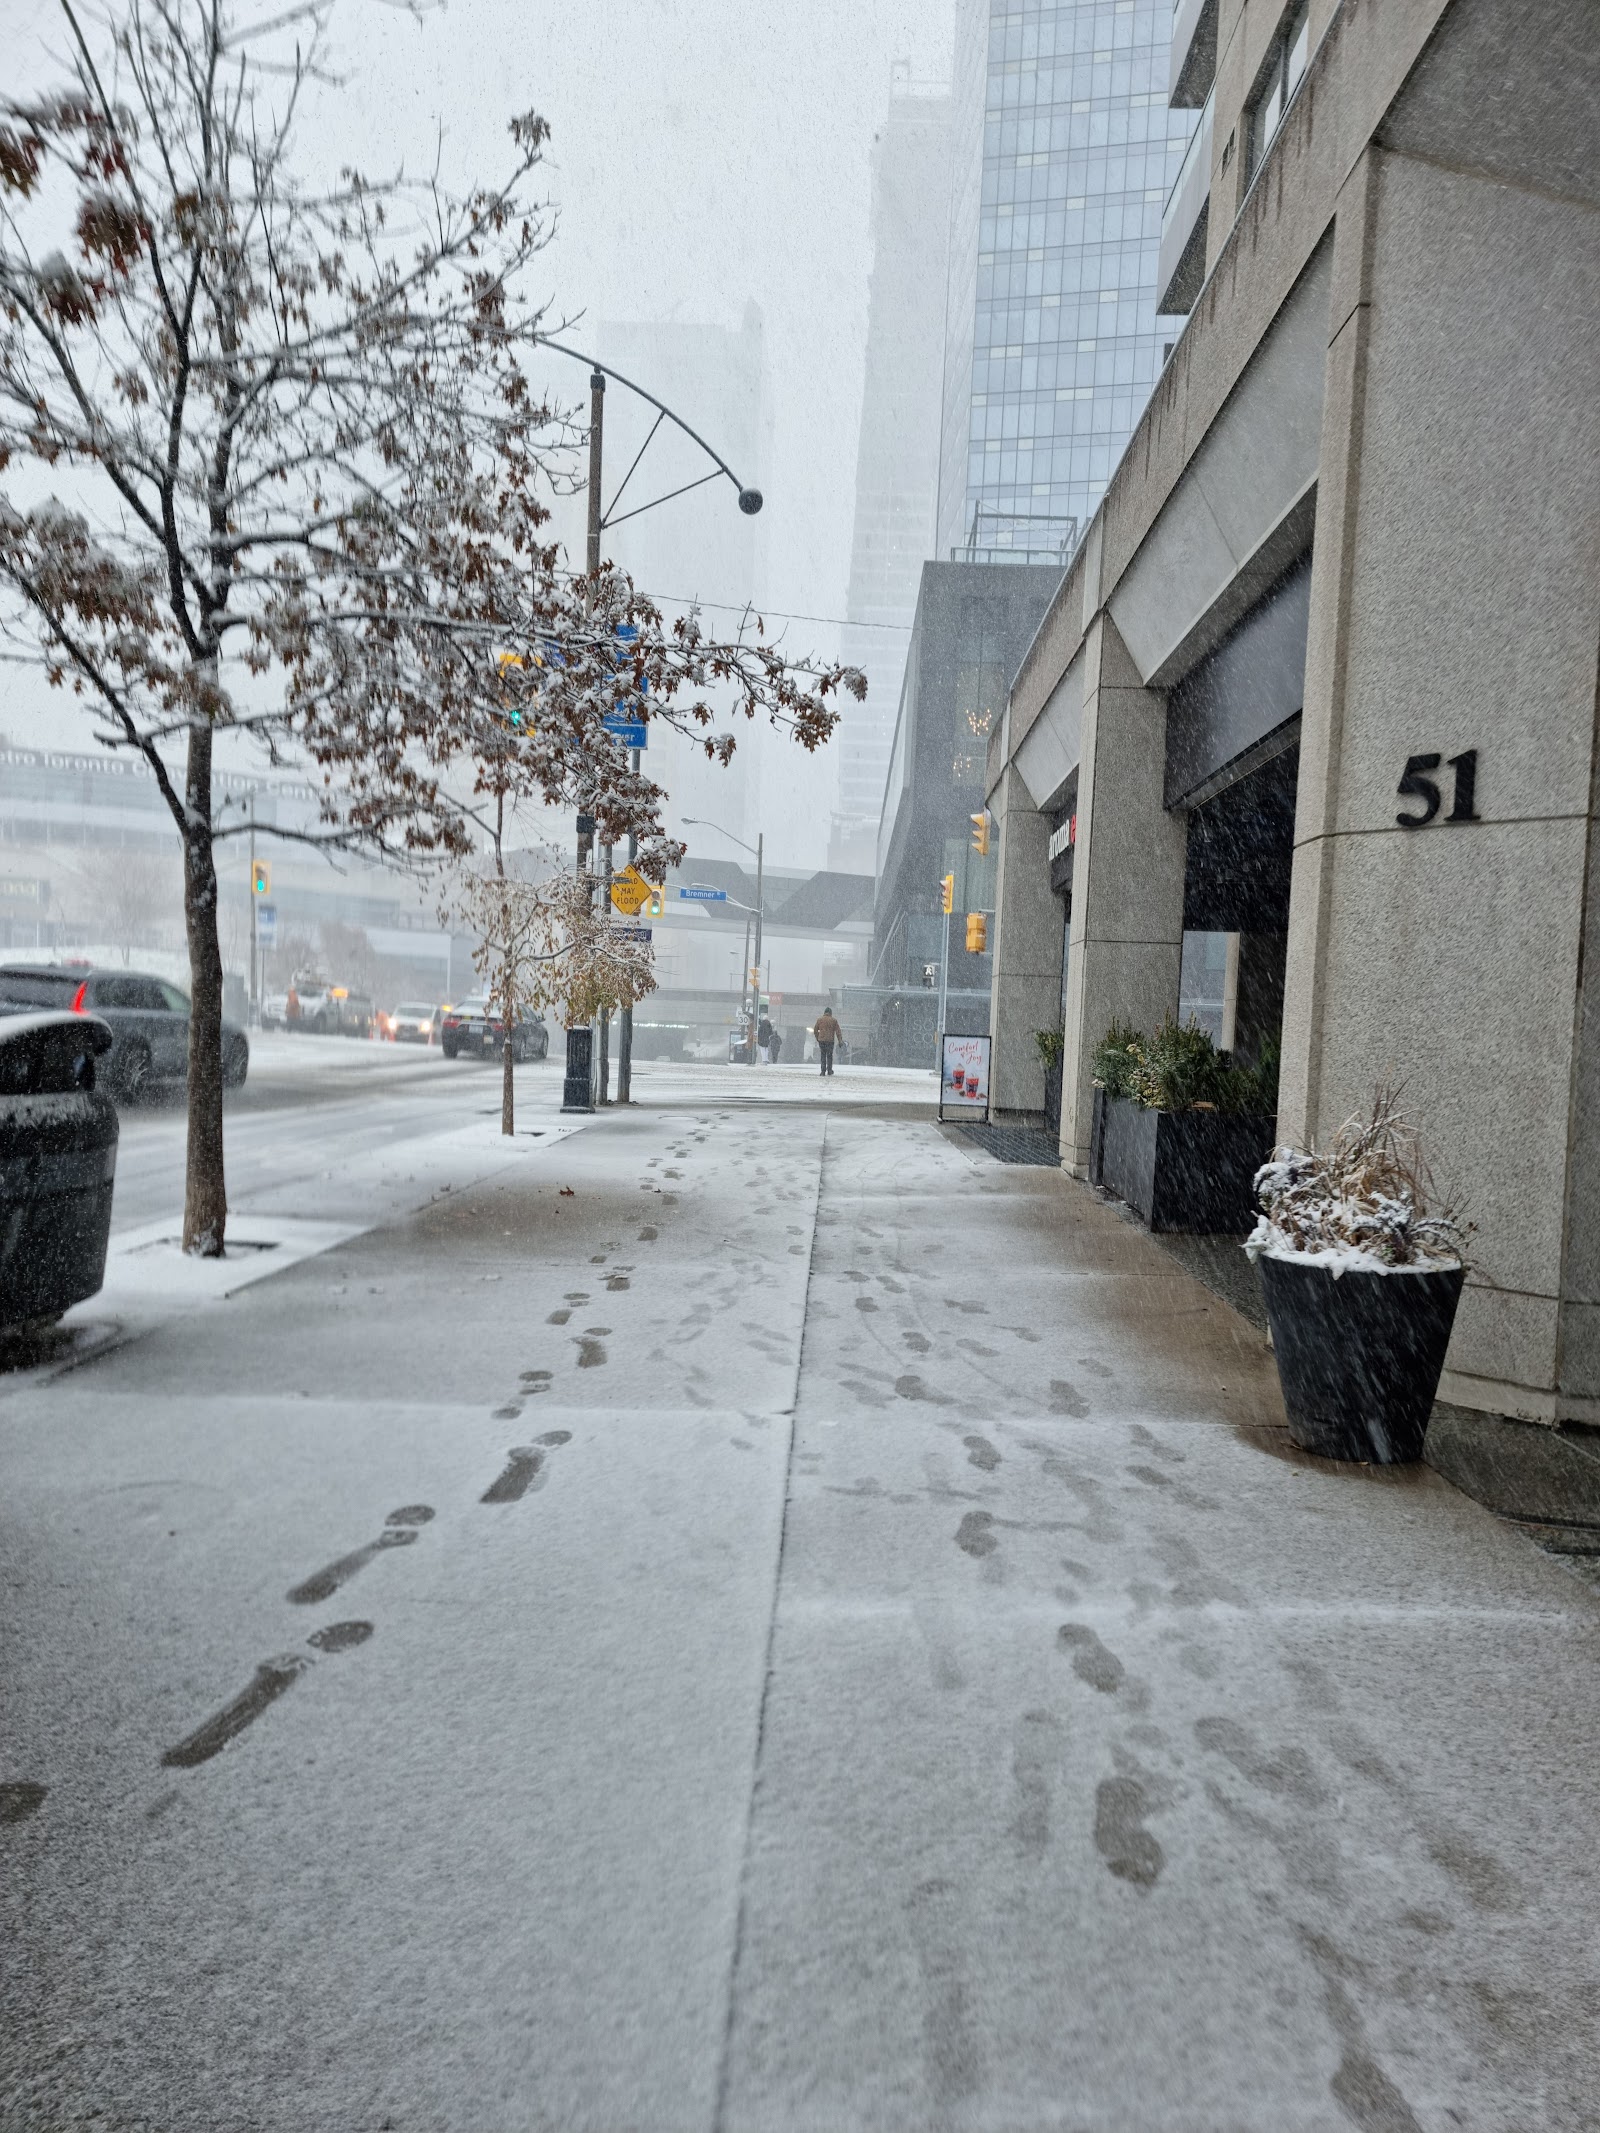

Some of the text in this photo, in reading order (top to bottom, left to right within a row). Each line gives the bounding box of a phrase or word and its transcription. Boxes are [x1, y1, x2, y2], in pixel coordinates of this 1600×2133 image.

[40, 750, 125, 776] Toronto
[1396, 749, 1481, 826] 51
[1048, 819, 1070, 861] aroma
[621, 887, 636, 895] MAY
[685, 889, 715, 899] Bremner
[616, 897, 639, 905] FLOOD
[738, 1016, 749, 1024] 30
[948, 1041, 978, 1053] Comfort
[965, 1054, 982, 1065] Joy
